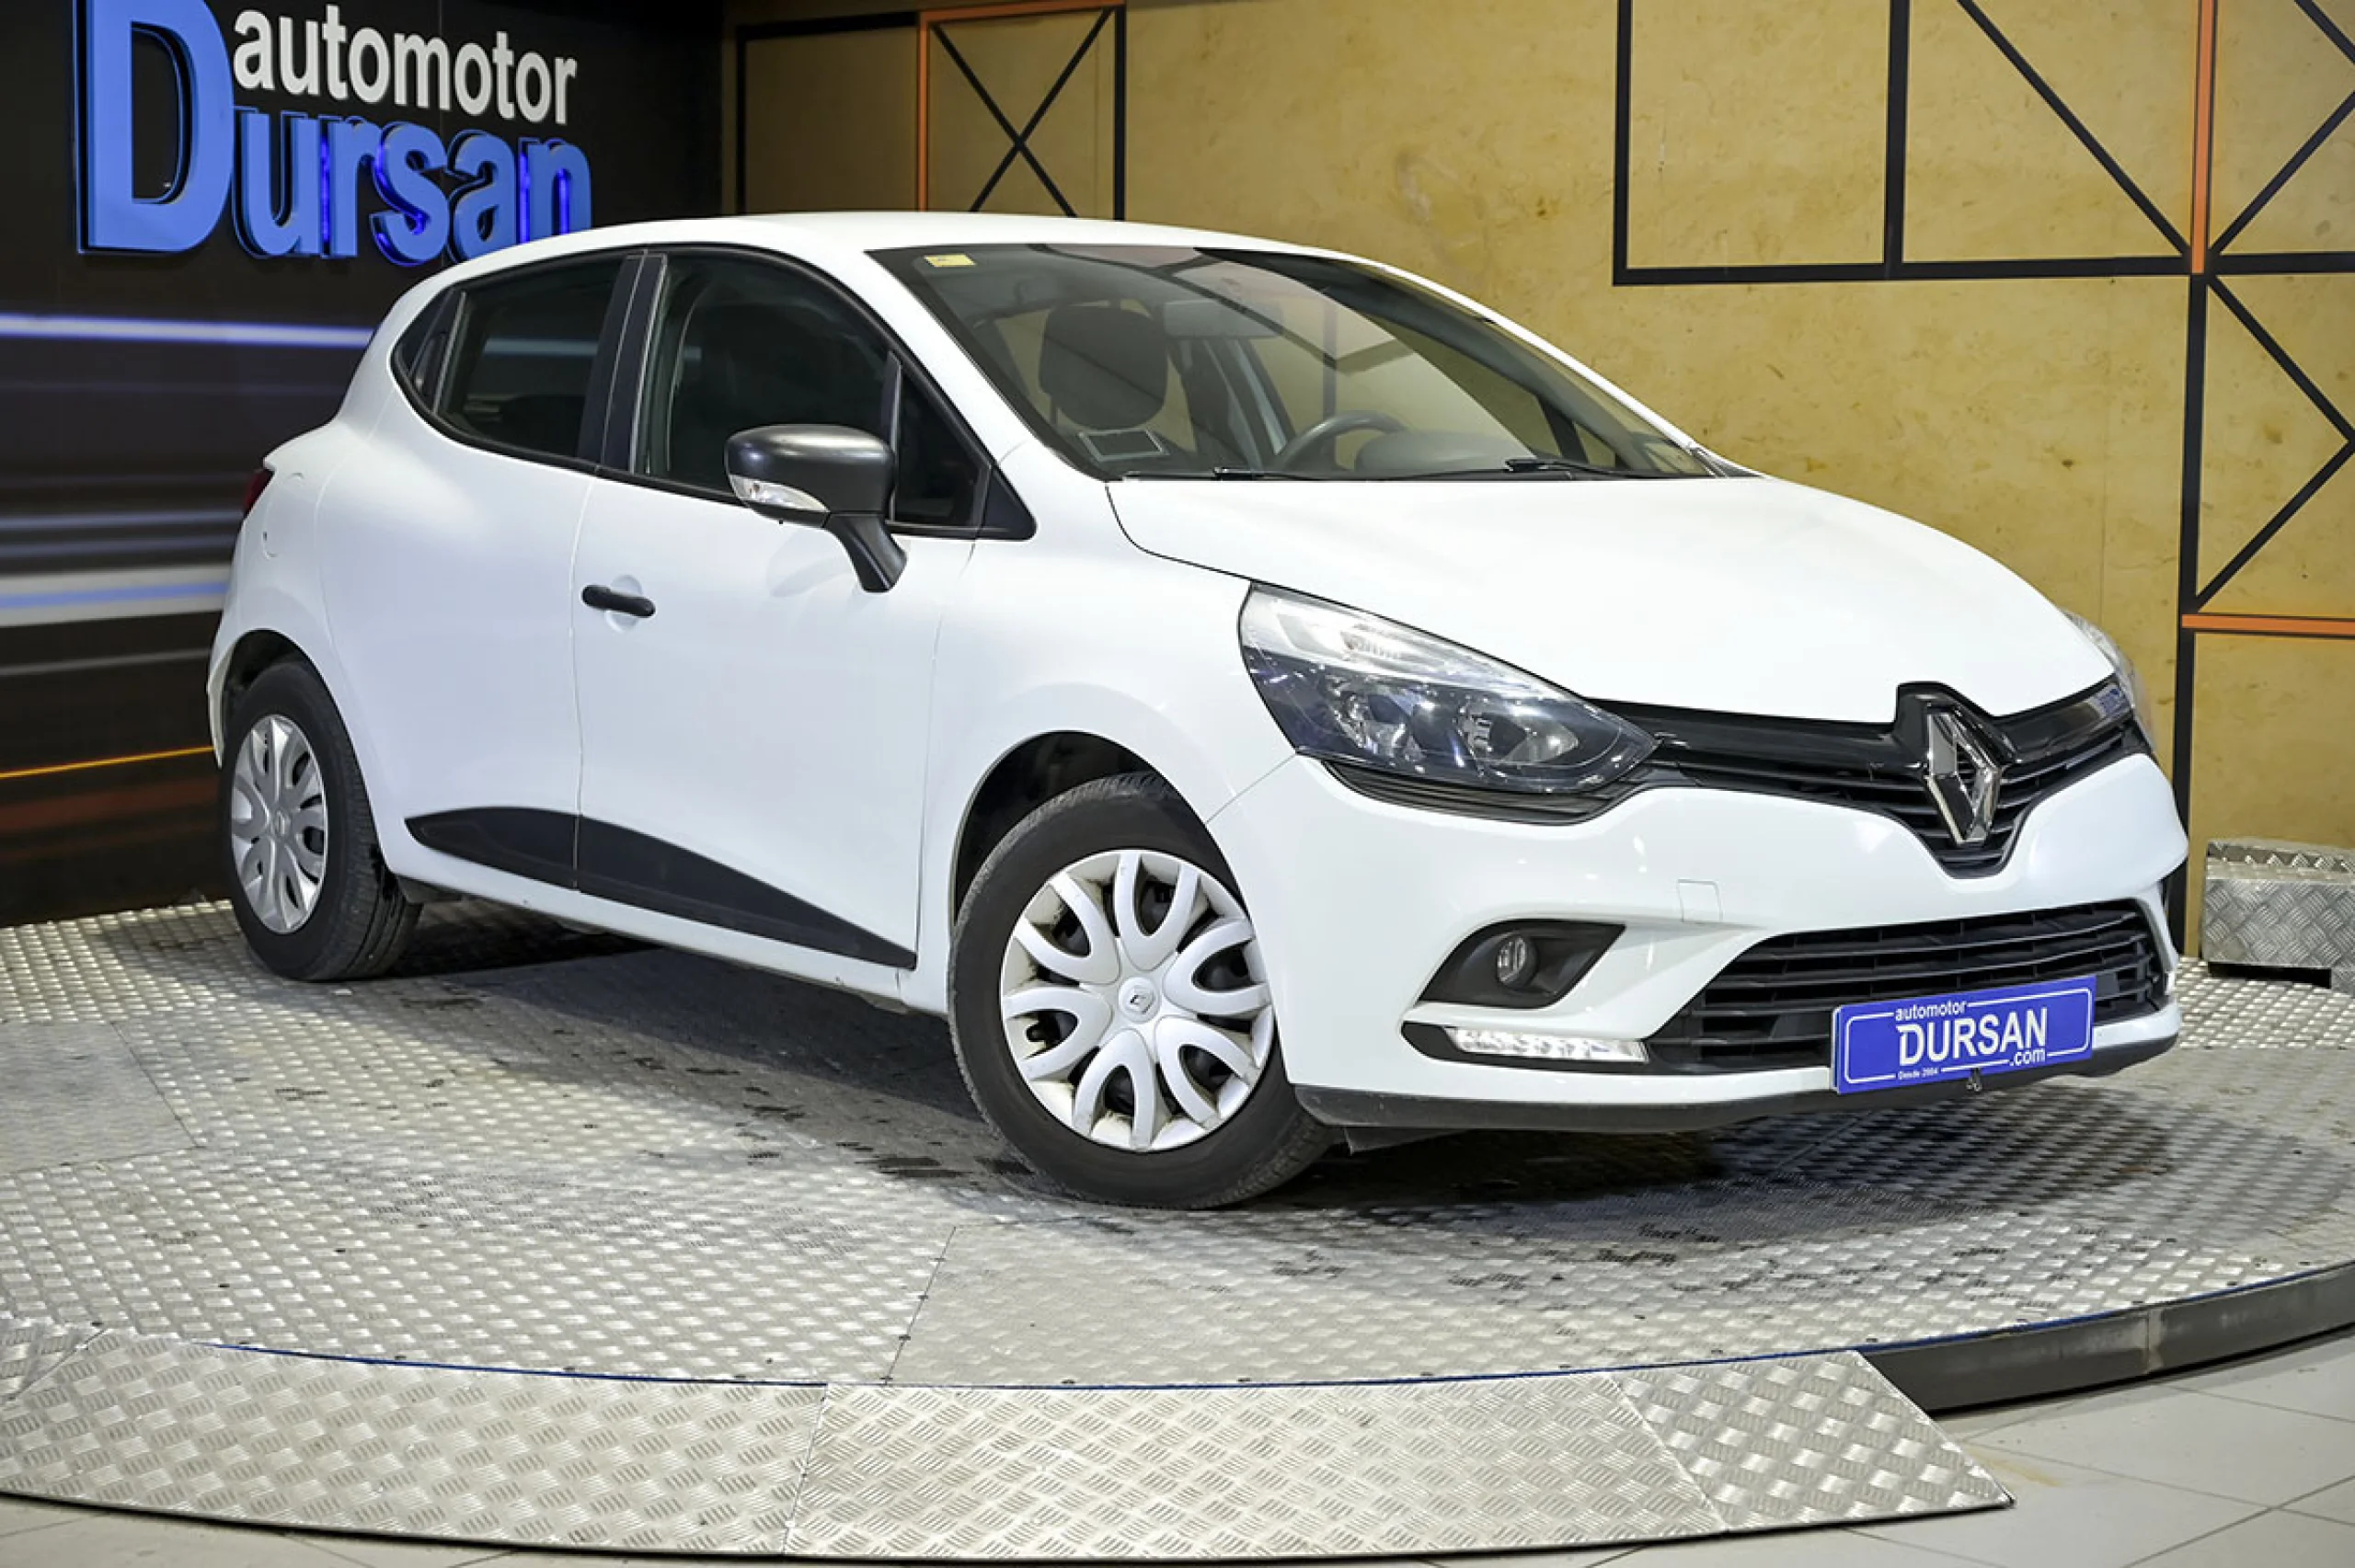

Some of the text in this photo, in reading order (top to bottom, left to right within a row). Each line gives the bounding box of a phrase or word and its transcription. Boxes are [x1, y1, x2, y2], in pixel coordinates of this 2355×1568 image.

[233, 4, 578, 125] automotor
[75, 0, 592, 265] Dursan
[1895, 1001, 1968, 1021] automotor
[1896, 1007, 2048, 1067] DURSAN
[2009, 1048, 2046, 1066] .com
